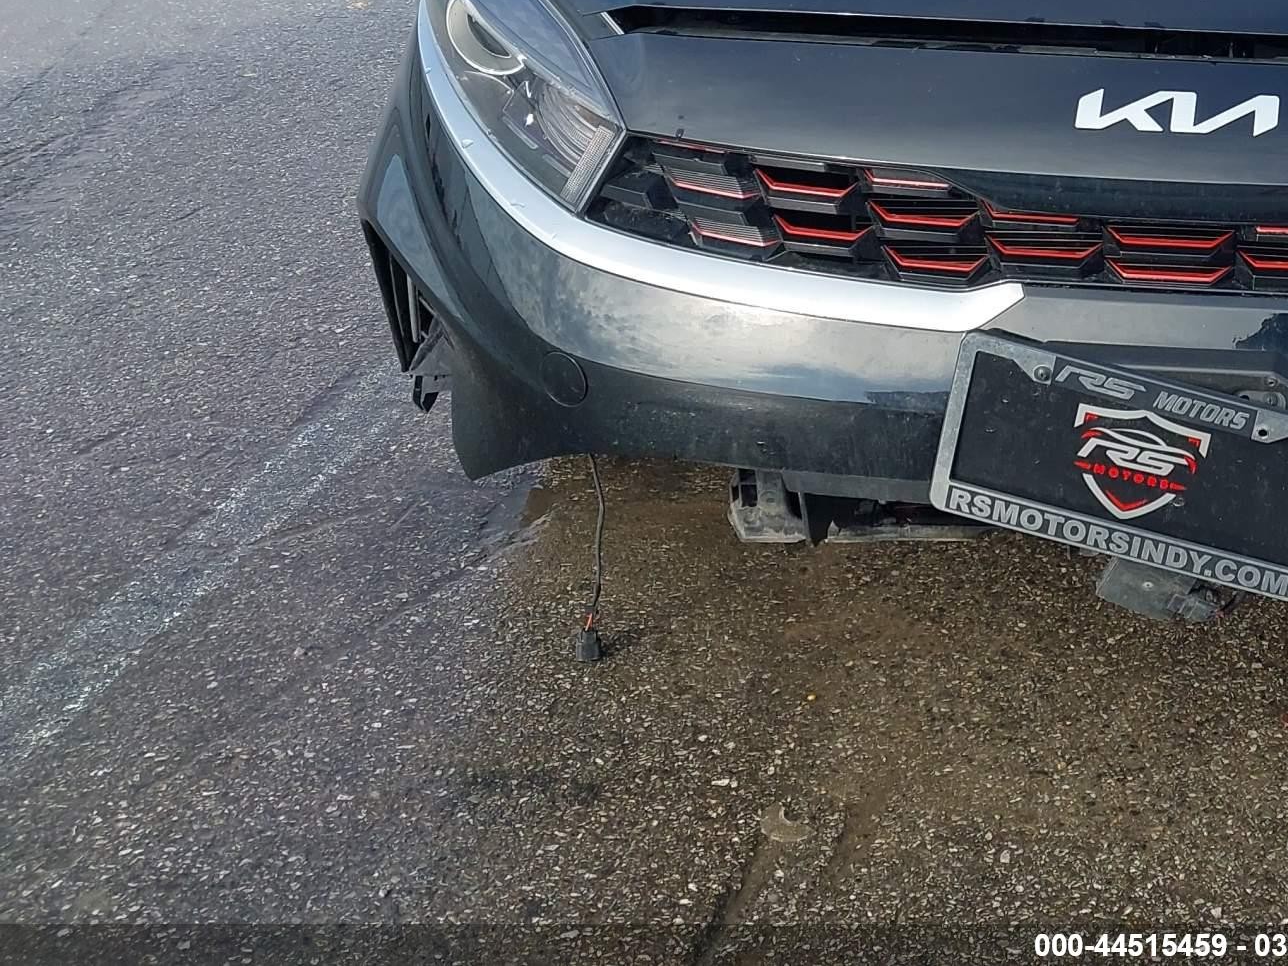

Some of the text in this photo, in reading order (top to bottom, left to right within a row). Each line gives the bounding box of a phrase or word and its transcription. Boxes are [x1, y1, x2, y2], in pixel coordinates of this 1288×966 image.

[1074, 88, 1280, 137] KIA
[1055, 365, 1250, 430] RS MOTORS
[1077, 437, 1189, 476] RS
[1093, 463, 1170, 490] MOTORS
